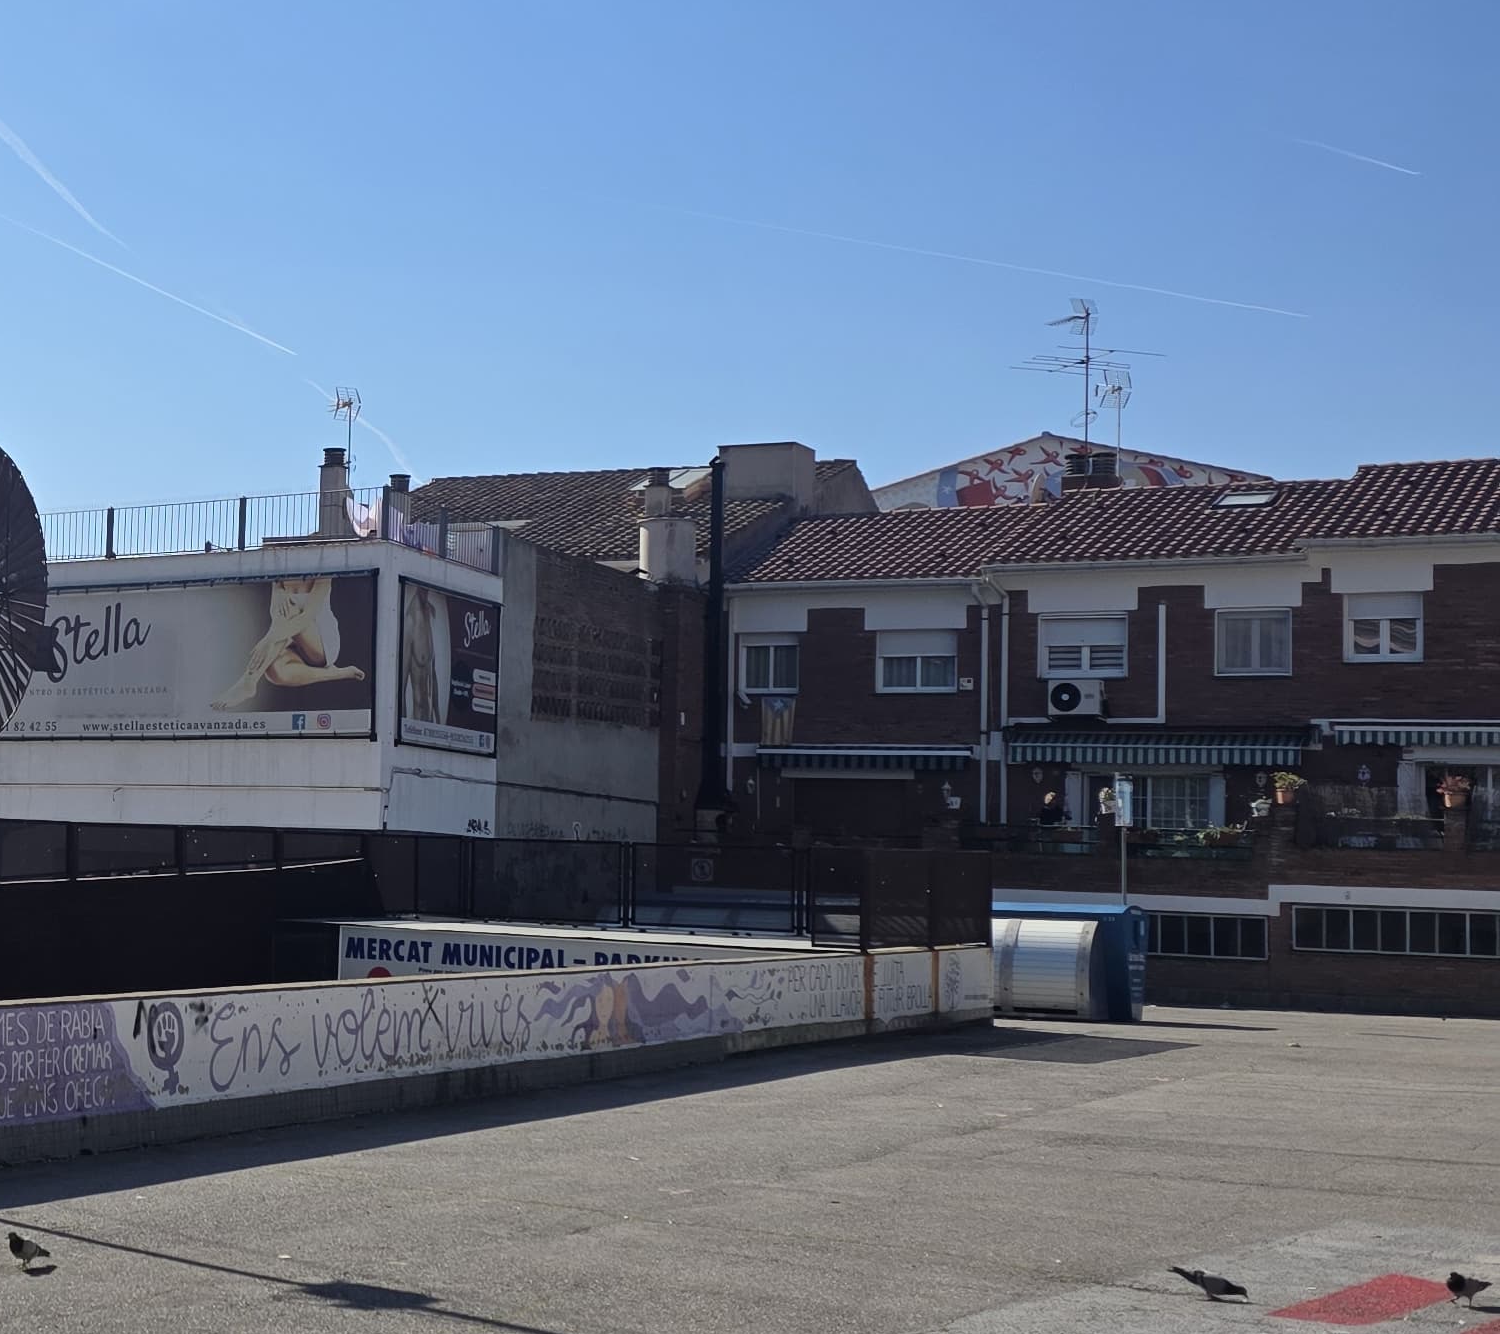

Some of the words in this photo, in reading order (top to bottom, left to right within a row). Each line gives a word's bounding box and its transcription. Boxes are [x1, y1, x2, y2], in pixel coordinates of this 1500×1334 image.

[46, 602, 151, 682] Stella
[464, 611, 491, 647] Stella
[14, 722, 26, 732] 82
[29, 721, 41, 731] 42
[45, 721, 57, 731] 55
[82, 719, 266, 732] www.stellaesteticaavanzada.es
[345, 936, 433, 964] MERCAT
[441, 942, 565, 969] MUNICIPAL
[36, 1010, 56, 1043] DE
[210, 1002, 300, 1092] Ens
[312, 987, 432, 1068] volem
[445, 994, 531, 1053] vives
[11, 1050, 35, 1082] PER
[37, 1047, 60, 1078] FER
[62, 1041, 113, 1076] CREMAR
